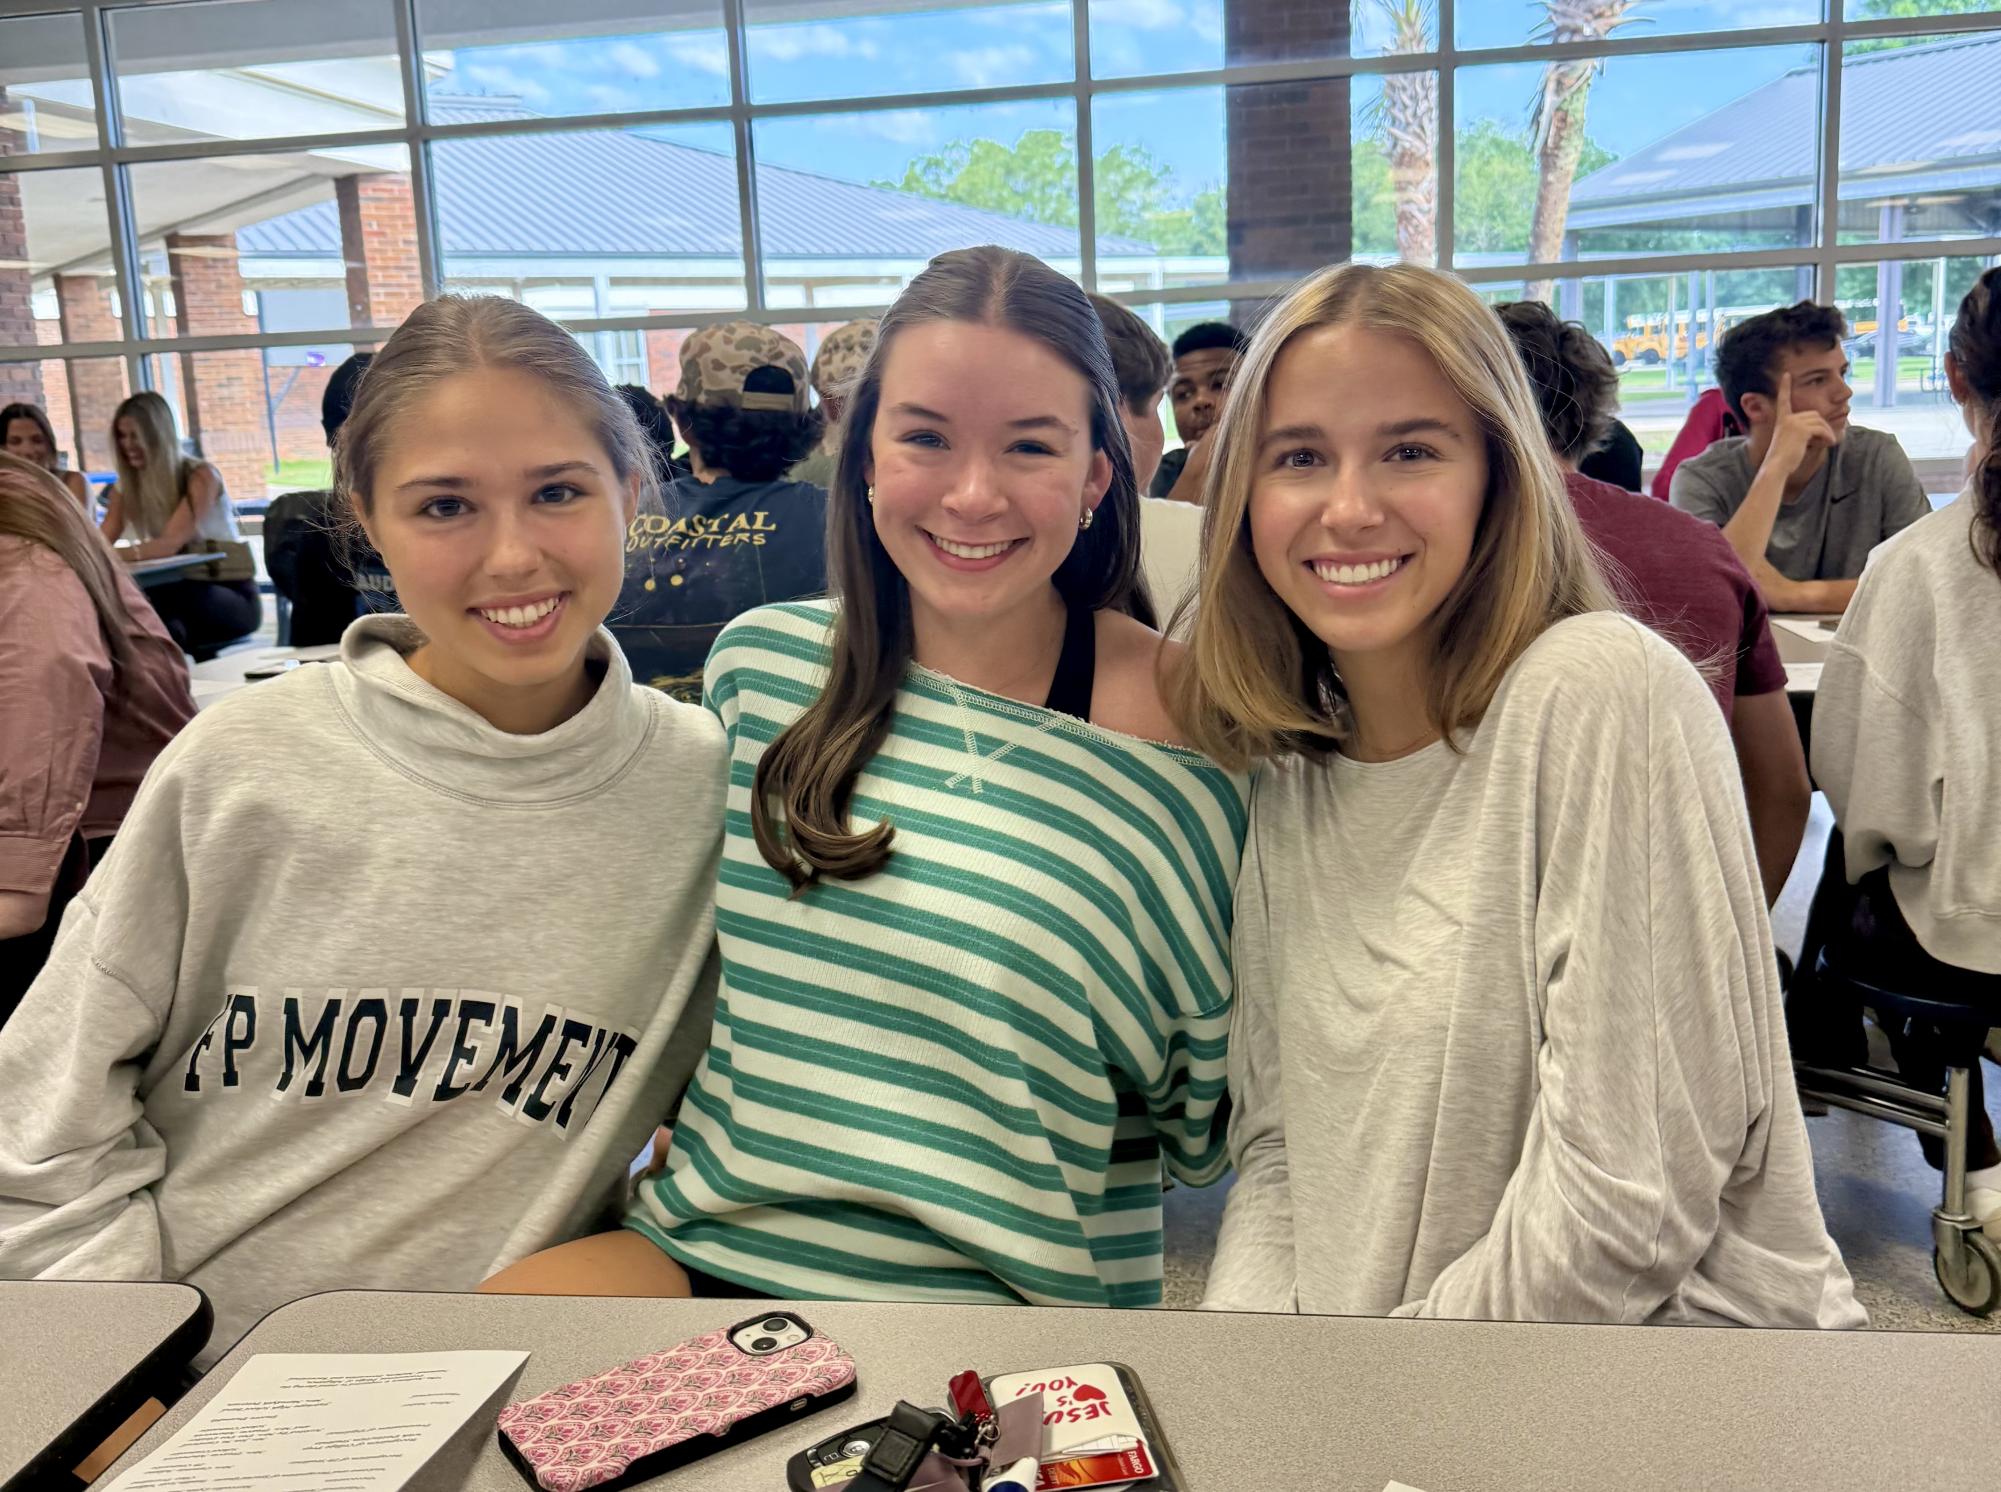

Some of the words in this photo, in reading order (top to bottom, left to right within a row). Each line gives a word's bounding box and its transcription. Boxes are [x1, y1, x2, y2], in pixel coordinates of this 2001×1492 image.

[628, 511, 777, 537] COASTAL
[625, 532, 767, 552] OUTFITTERS
[1015, 1376, 1078, 1396] YOU!
[1041, 1401, 1112, 1426] JESU
[1127, 1450, 1144, 1475] FARGO
